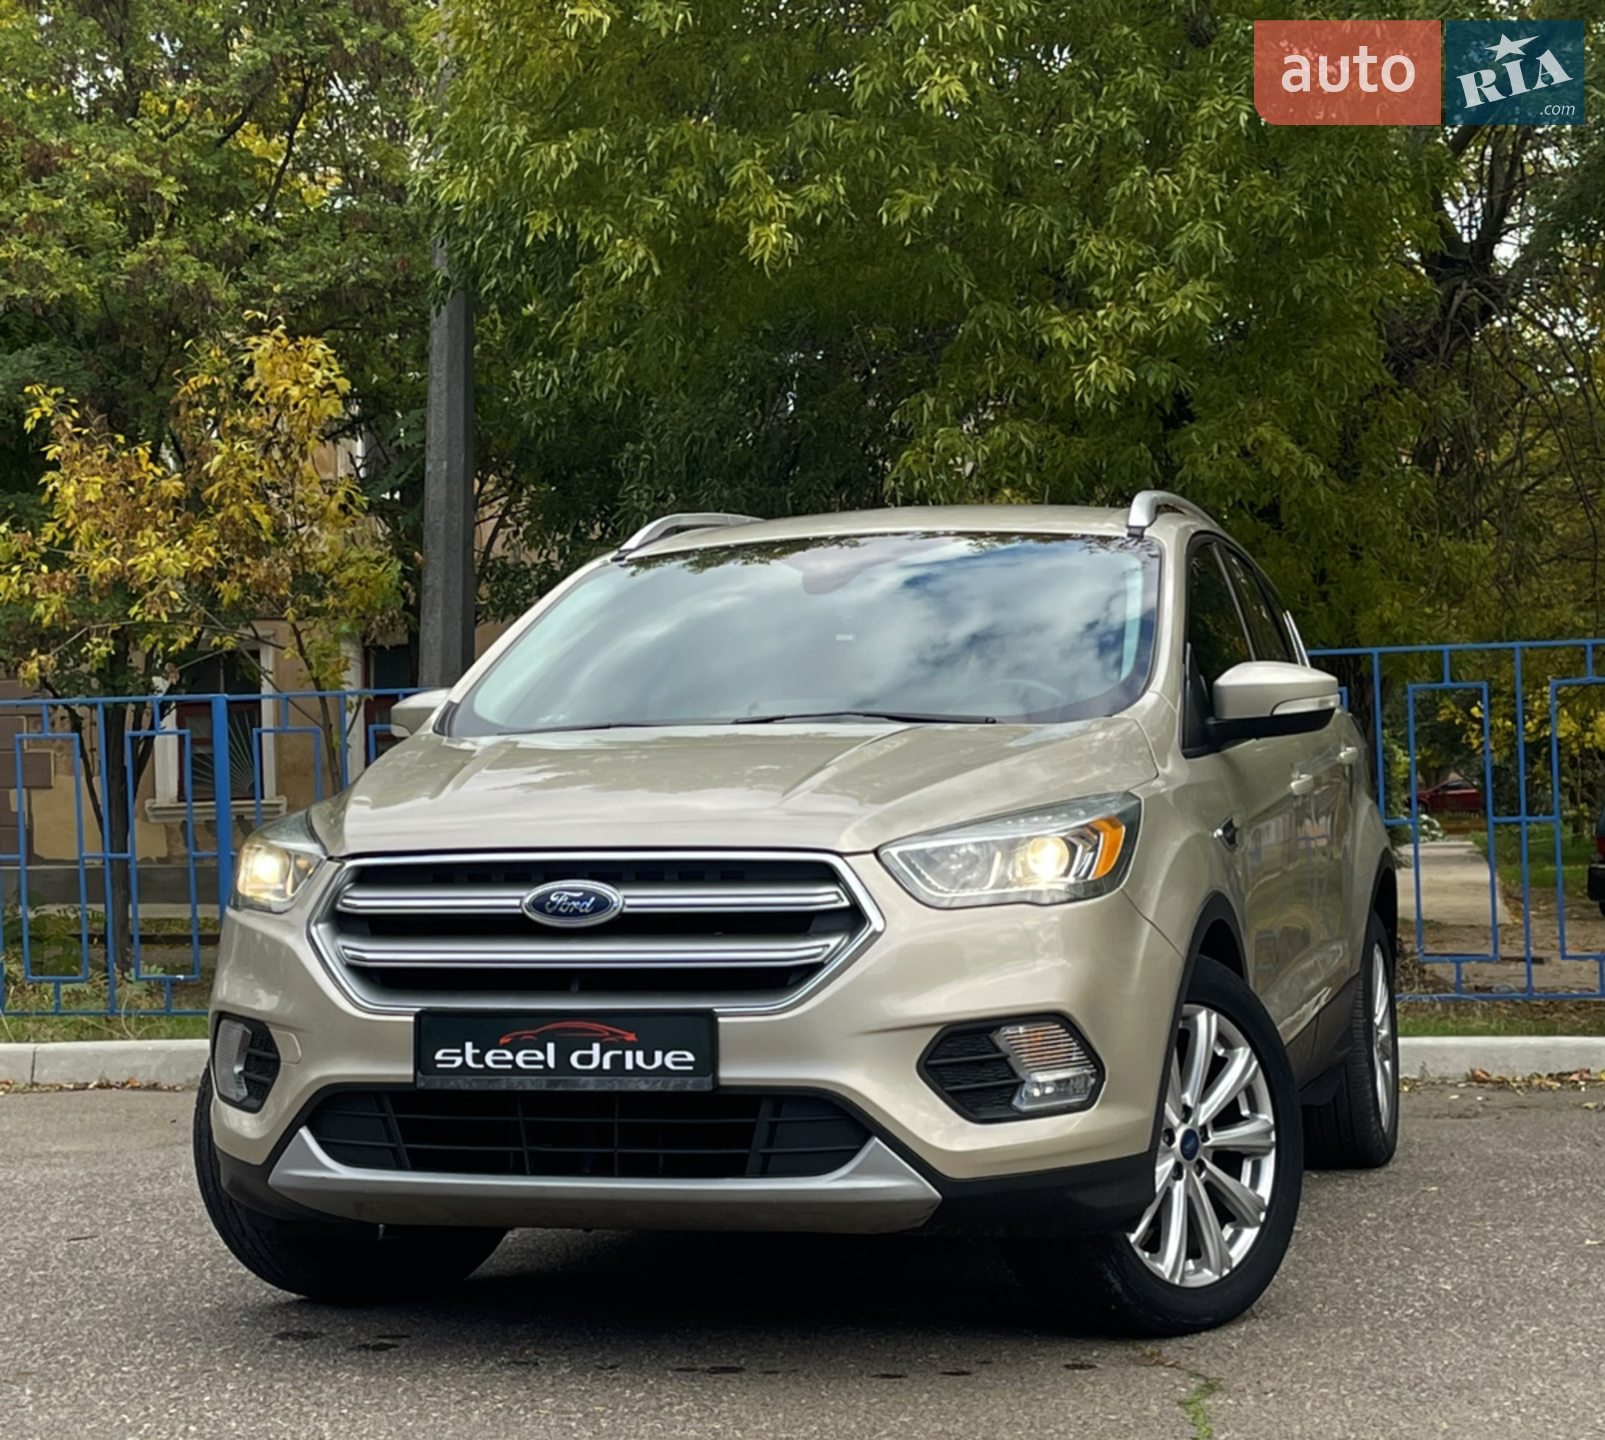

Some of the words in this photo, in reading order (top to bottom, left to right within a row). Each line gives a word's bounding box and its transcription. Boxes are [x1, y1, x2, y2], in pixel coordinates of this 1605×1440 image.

[545, 890, 596, 914] Ford
[434, 1041, 555, 1069] steel
[569, 1042, 696, 1070] drive
